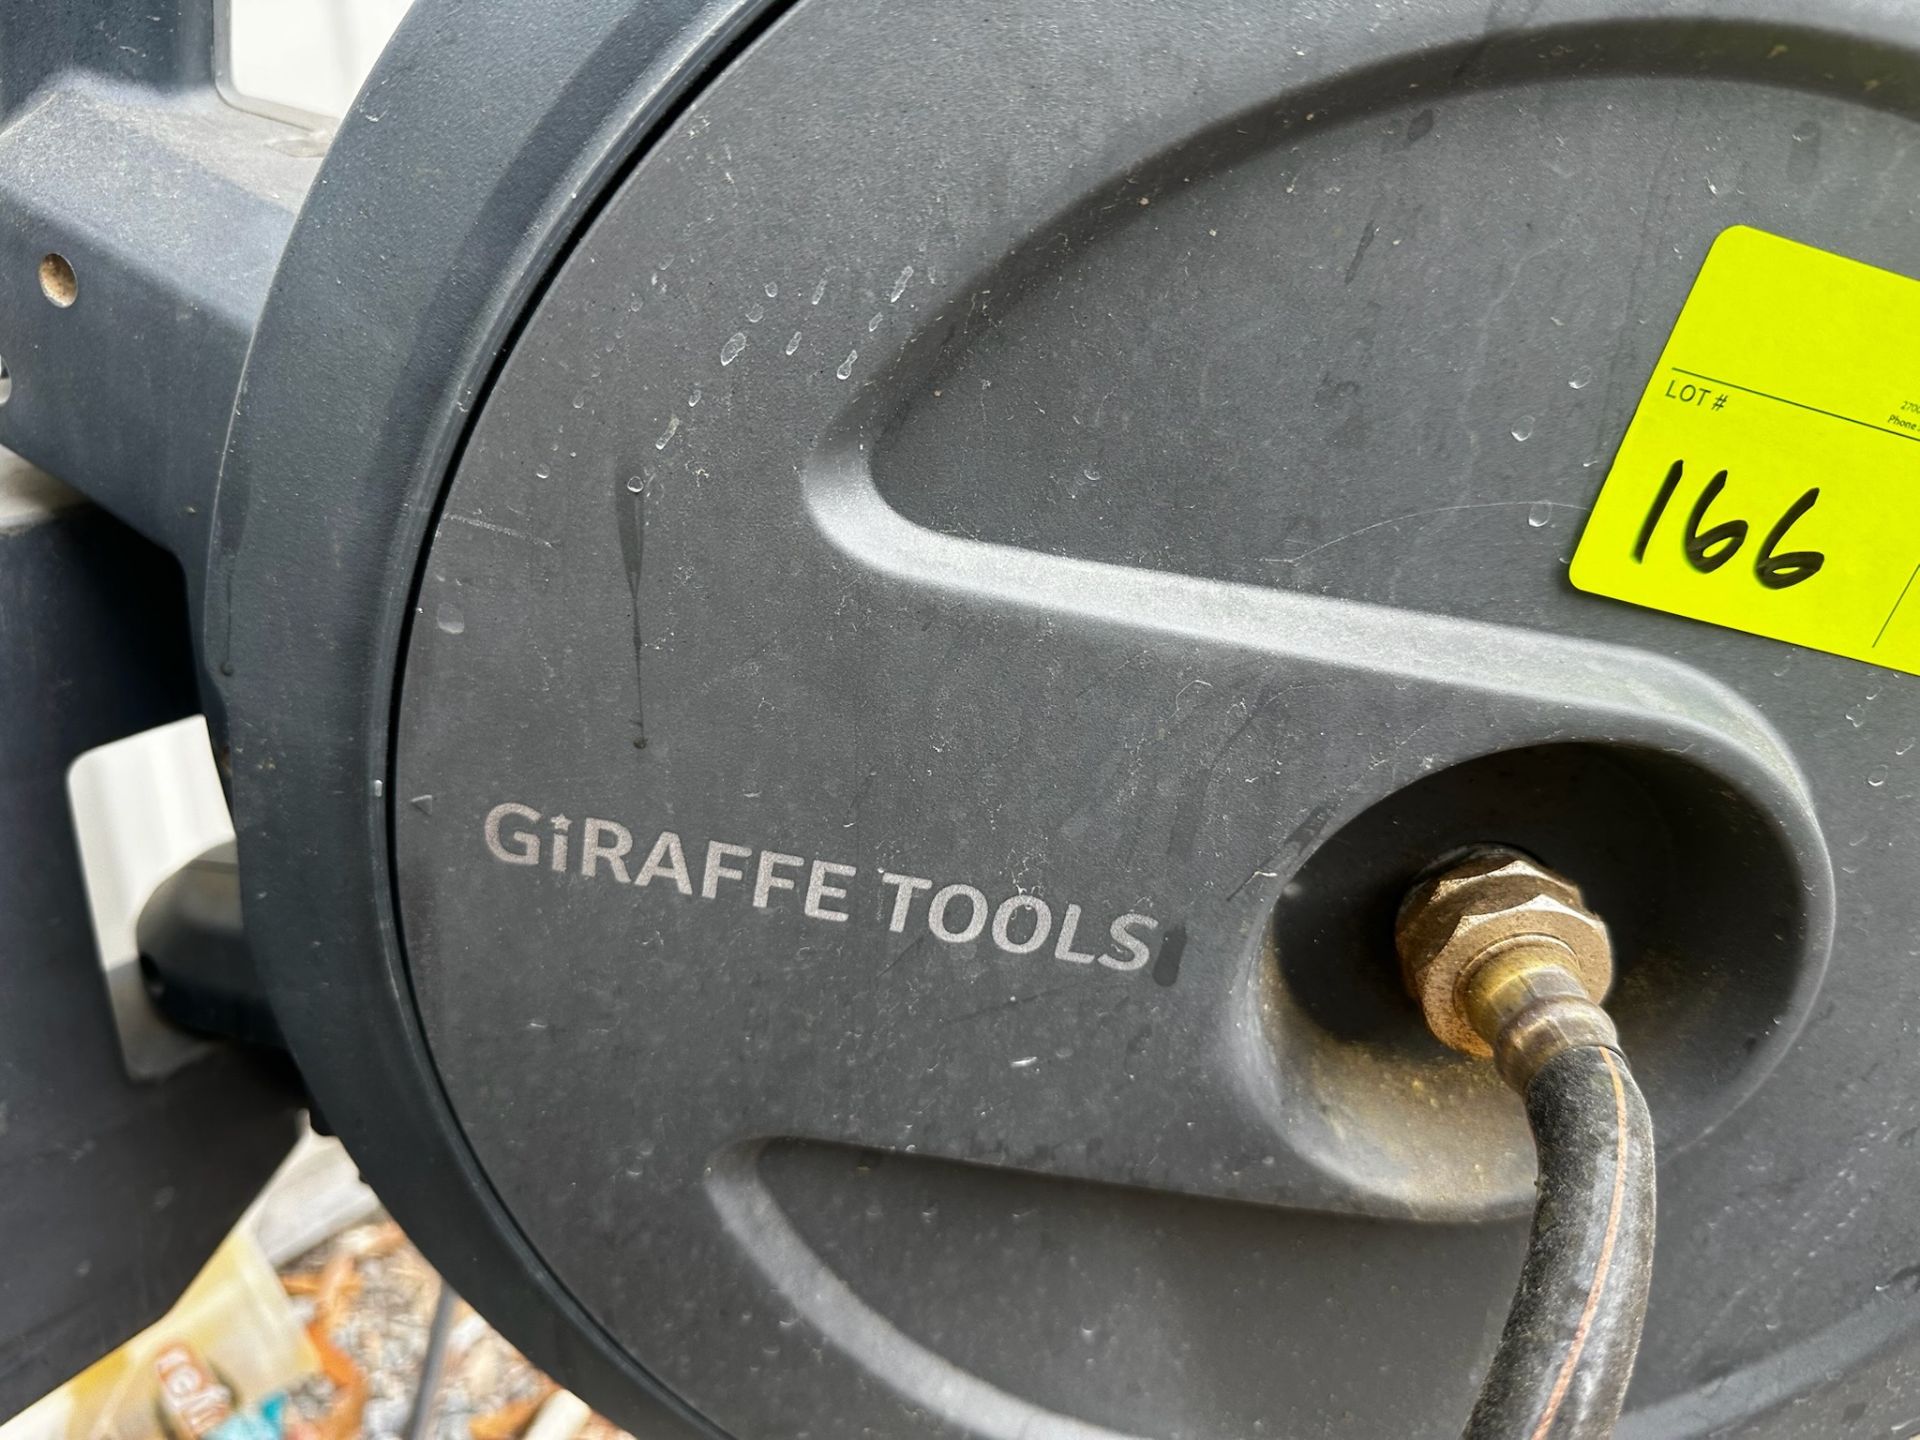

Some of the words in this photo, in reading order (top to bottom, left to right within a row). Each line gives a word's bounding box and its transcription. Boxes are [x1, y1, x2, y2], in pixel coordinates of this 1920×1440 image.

[1665, 381, 1711, 407] LOT
[1713, 394, 1728, 410] #
[1887, 414, 1917, 430] Phone
[1632, 459, 1825, 590] 166
[484, 802, 858, 923] GiRAFFE
[881, 871, 1159, 972] TOOLS
